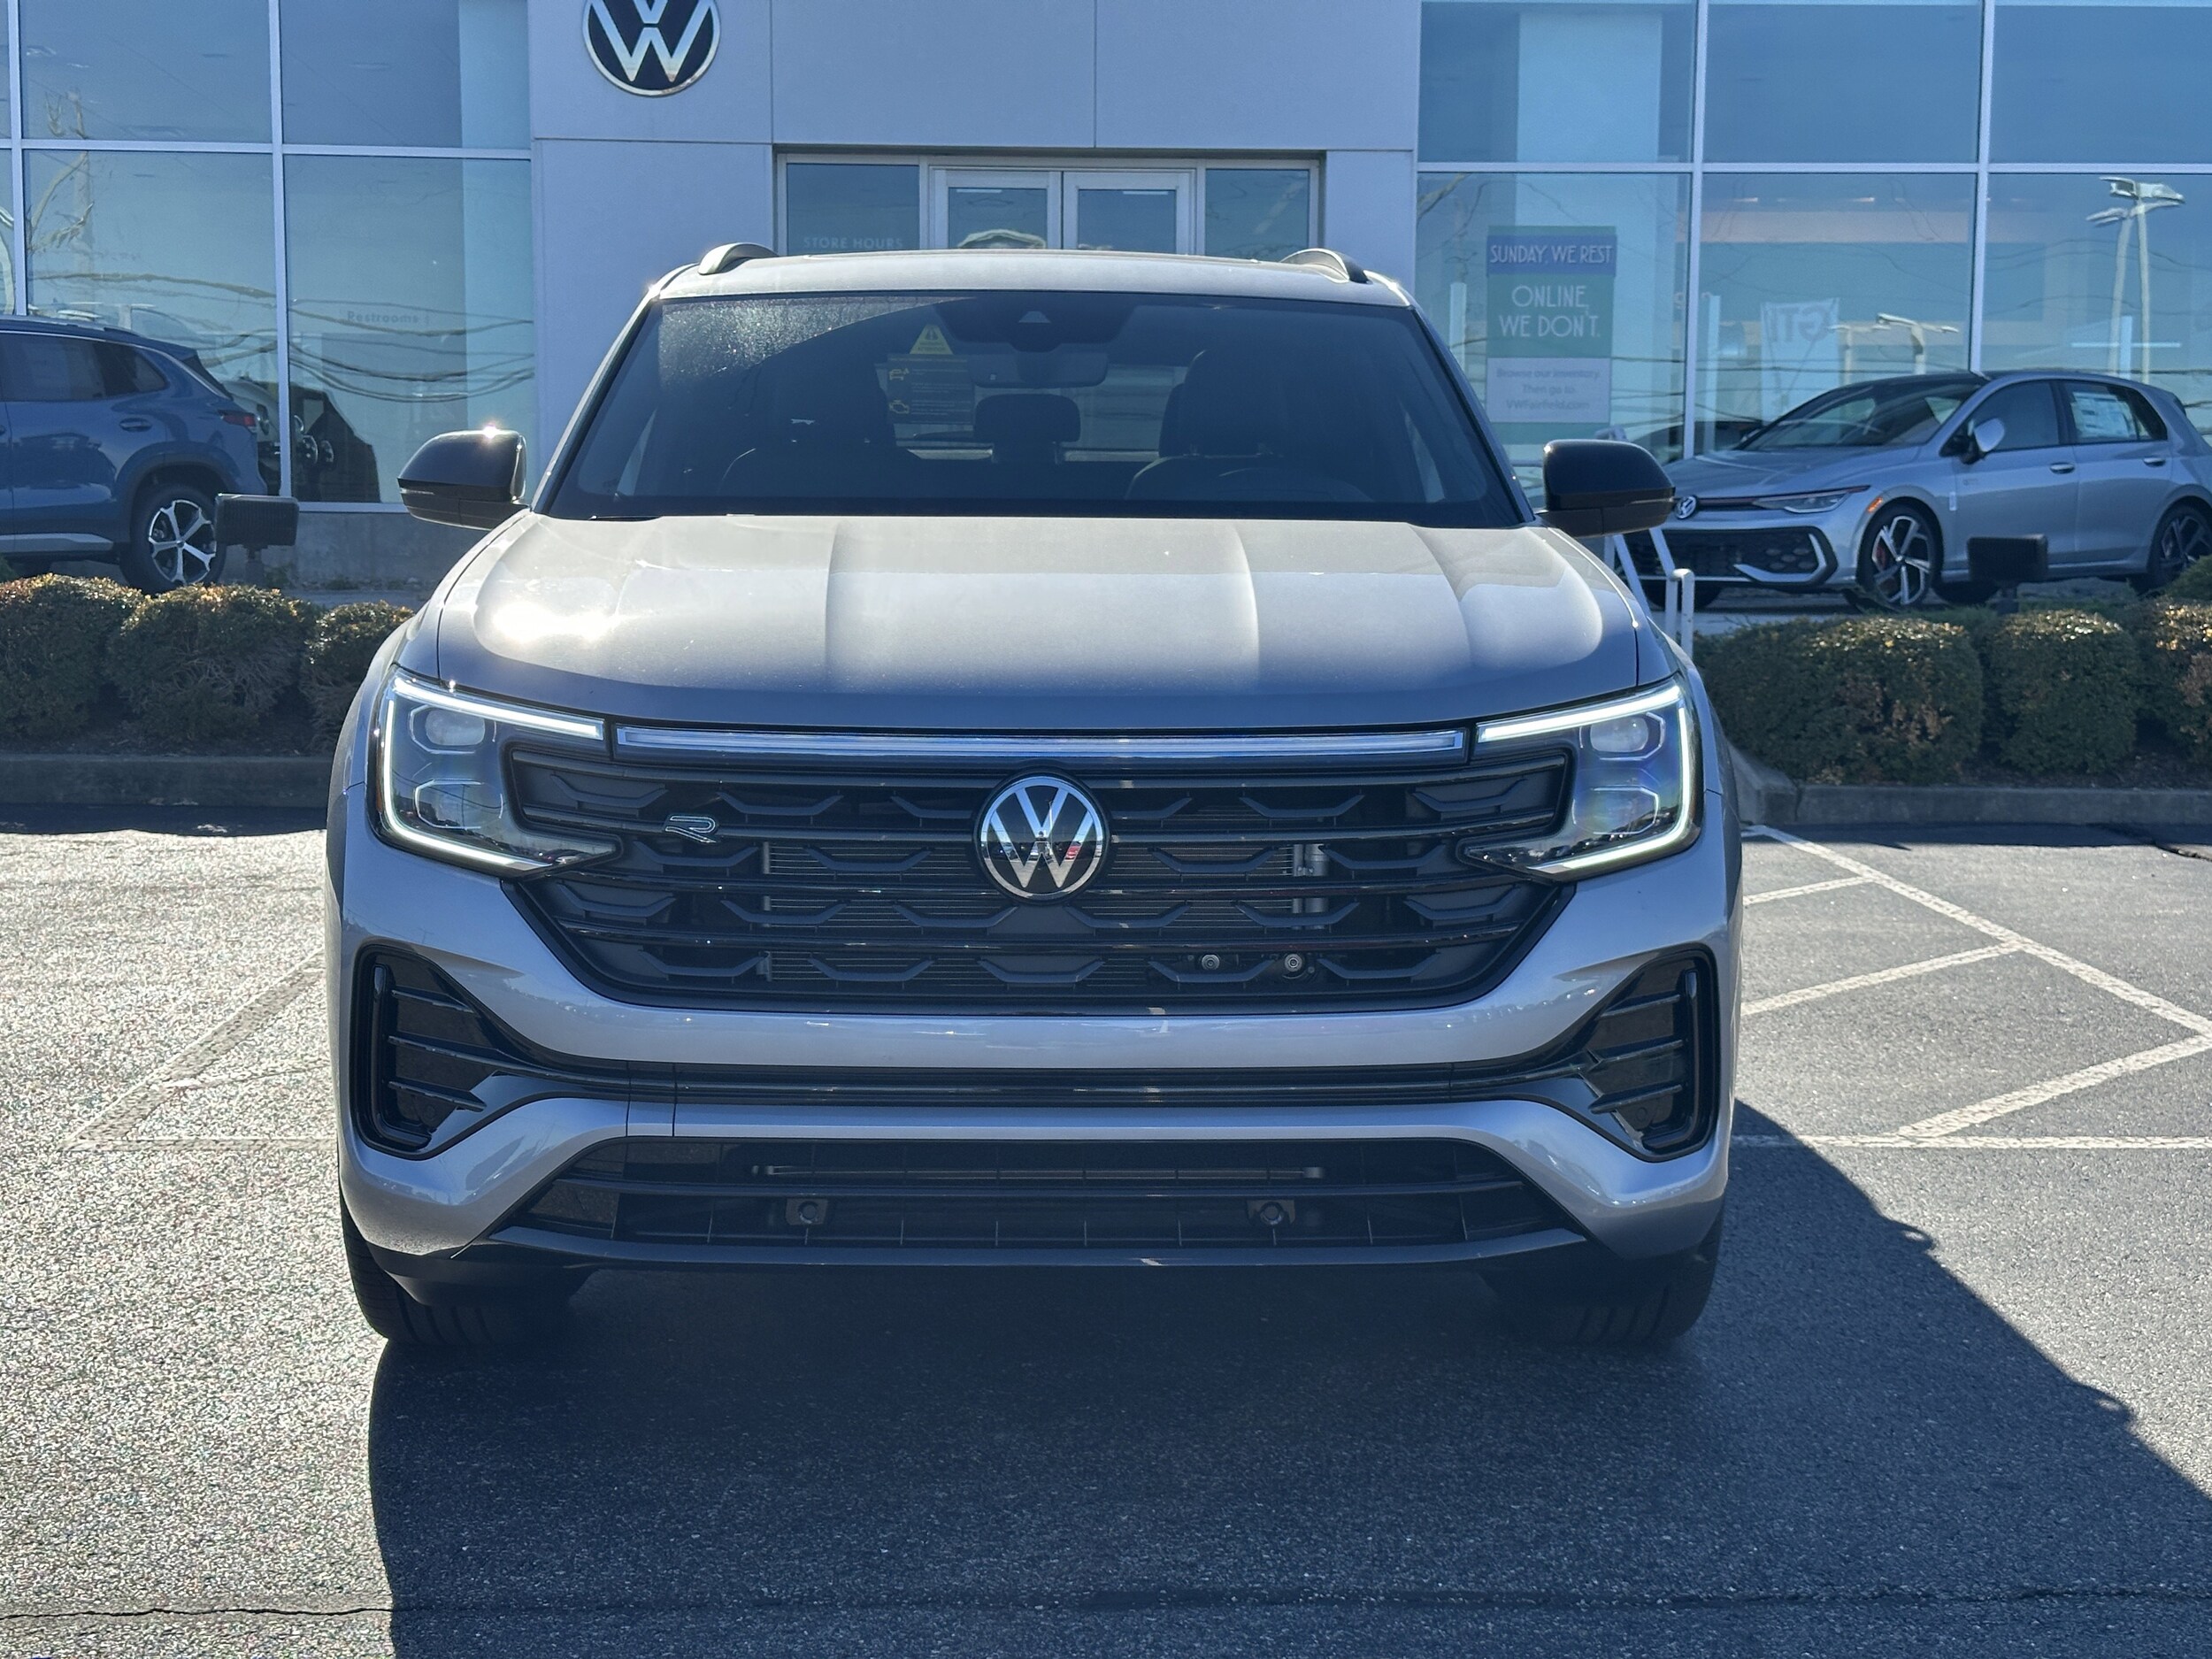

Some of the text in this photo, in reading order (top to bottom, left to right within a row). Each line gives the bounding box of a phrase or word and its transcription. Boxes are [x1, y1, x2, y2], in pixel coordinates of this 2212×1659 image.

[803, 236, 903, 250] STORE HOURS
[1551, 245, 1576, 263] WE
[1579, 245, 1612, 264] REST
[1511, 285, 1589, 310] ONLINE,
[347, 311, 419, 323] Restrooms
[1499, 311, 1601, 337] WE DON'T.
[664, 815, 718, 843] R
